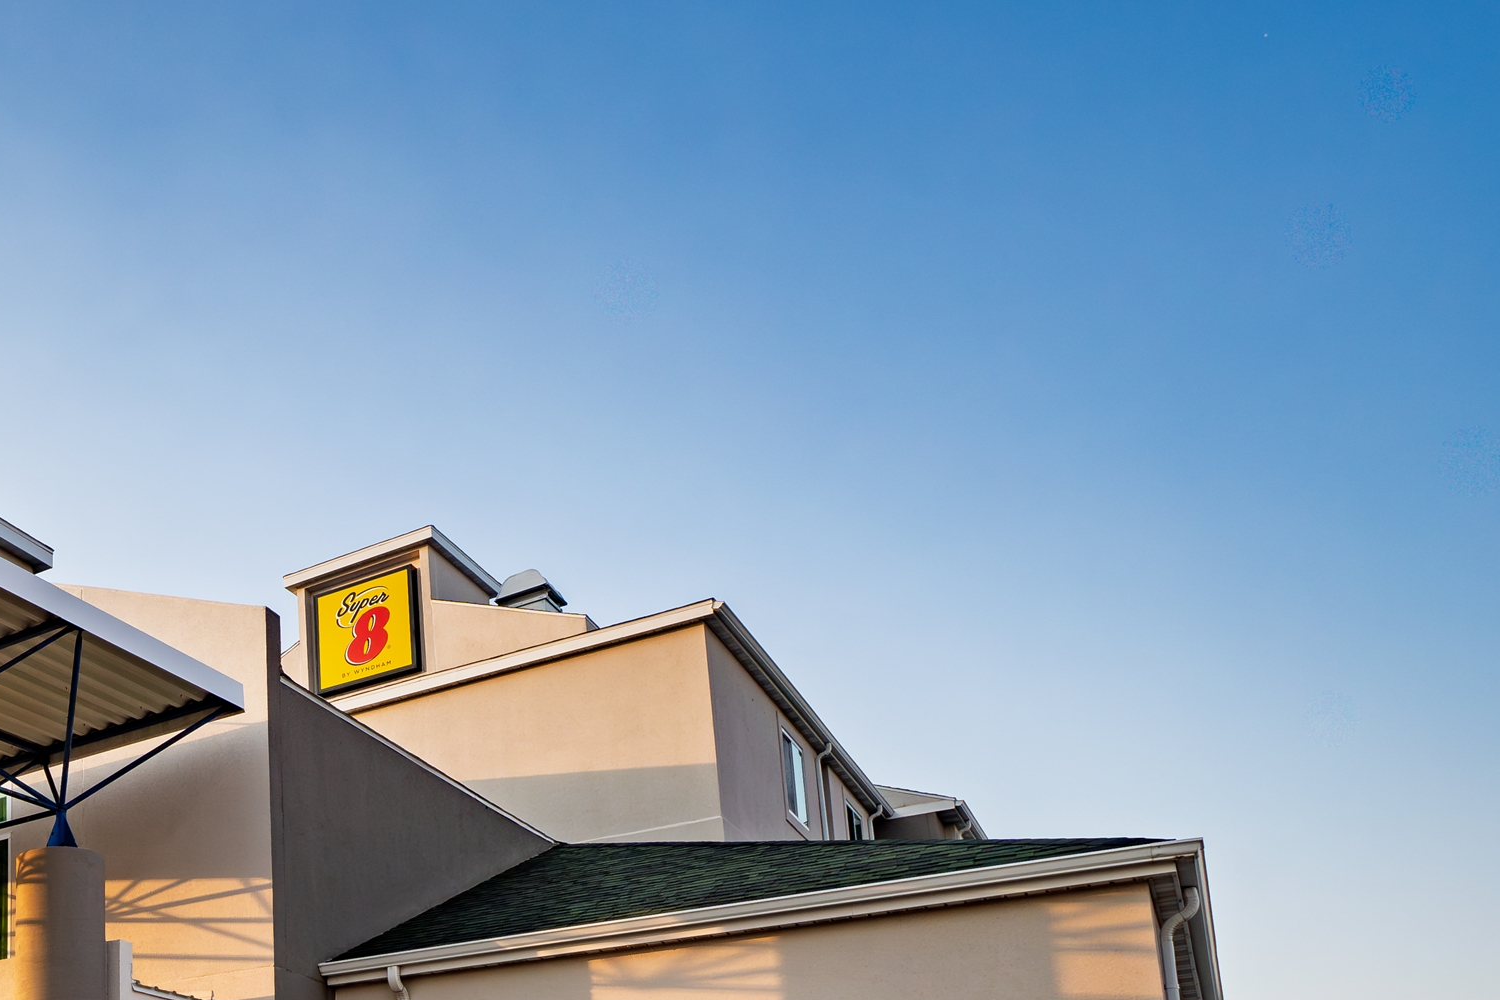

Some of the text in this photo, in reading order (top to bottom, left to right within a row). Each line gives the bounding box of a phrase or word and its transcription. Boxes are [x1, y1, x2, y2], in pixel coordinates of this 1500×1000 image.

[336, 587, 390, 627] Super
[344, 606, 390, 666] 8
[354, 660, 392, 675] WYNDHAM
